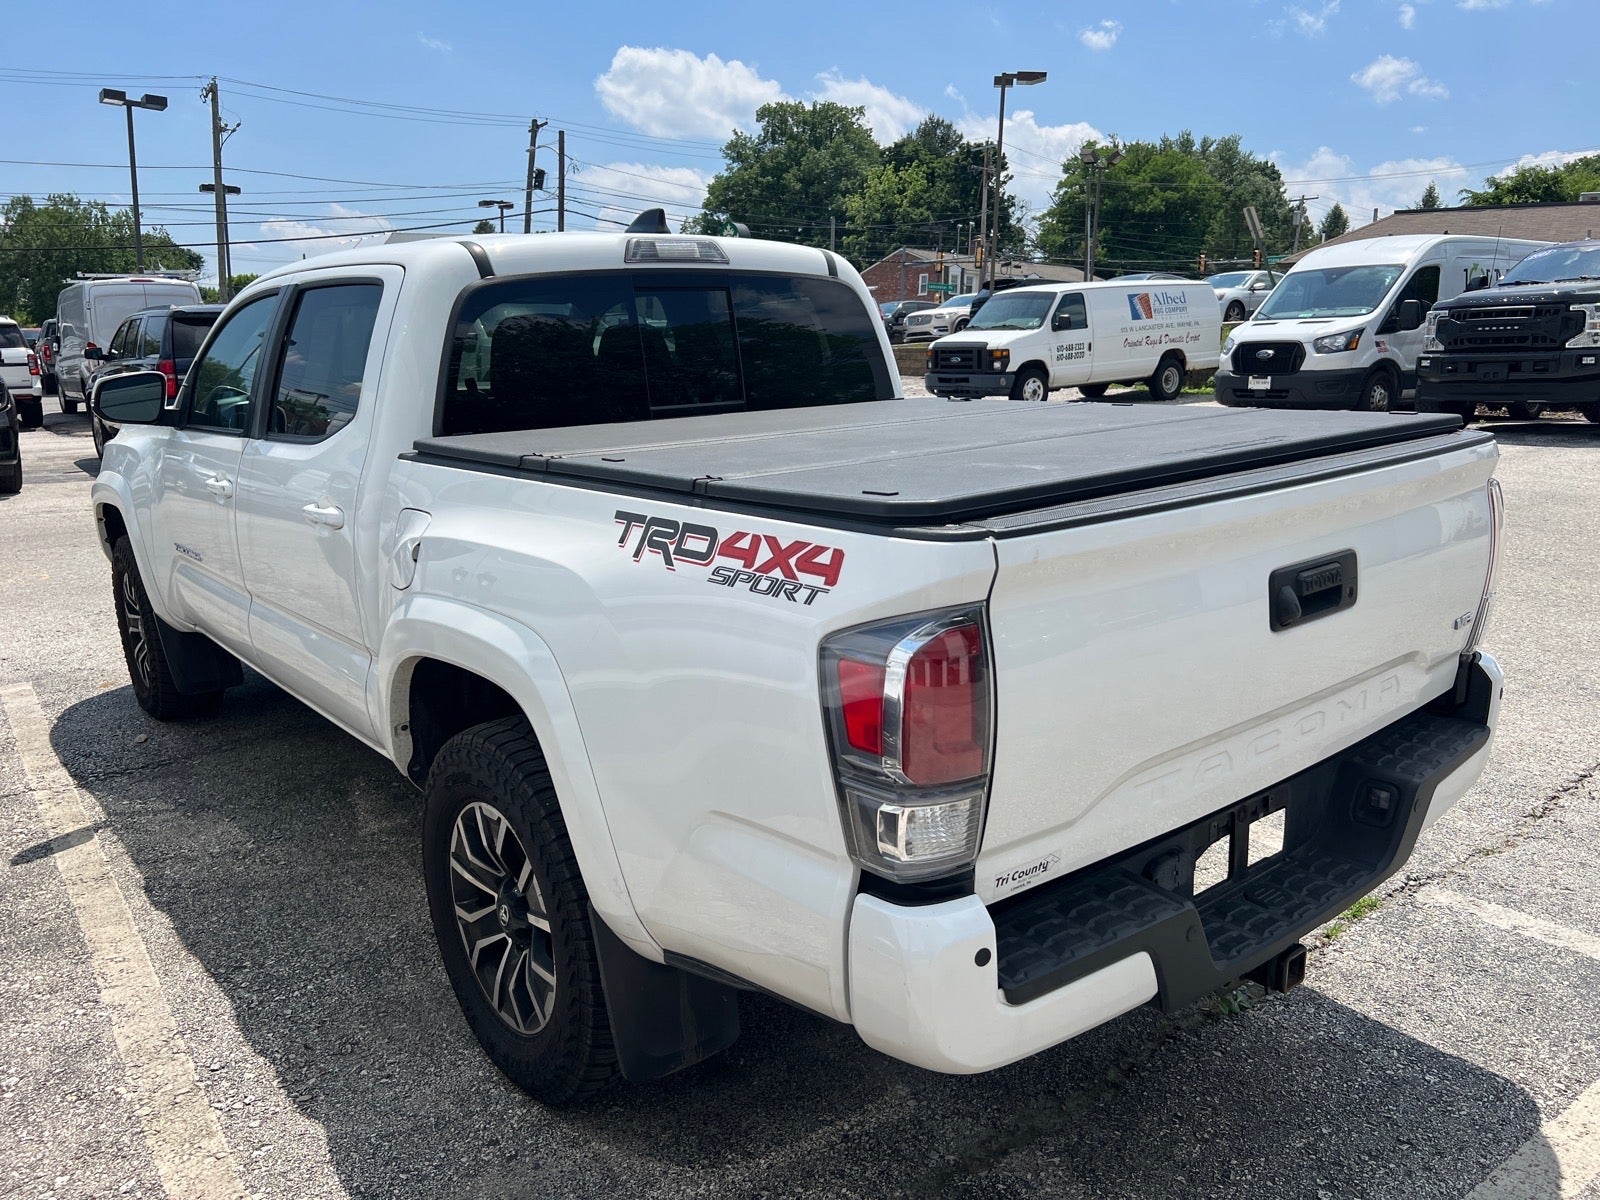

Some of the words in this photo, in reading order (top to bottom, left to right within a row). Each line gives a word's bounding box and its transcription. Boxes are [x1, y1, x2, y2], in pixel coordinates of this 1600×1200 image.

[1153, 291, 1187, 305] Albed
[1165, 306, 1188, 314] COMPANY
[1135, 323, 1164, 332] LANCASTER
[1056, 342, 1085, 353] 610-688-2323
[1123, 337, 1144, 348] Oriental
[1144, 335, 1158, 348] Rugs
[1158, 334, 1163, 344] &
[1163, 333, 1184, 345] Domestic
[614, 510, 720, 571] TRD
[707, 565, 831, 606] SPORT
[1304, 567, 1344, 593] TOYOTA
[1134, 674, 1401, 801] TACOMA
[995, 873, 1010, 888] Tri
[1011, 860, 1050, 881] County
